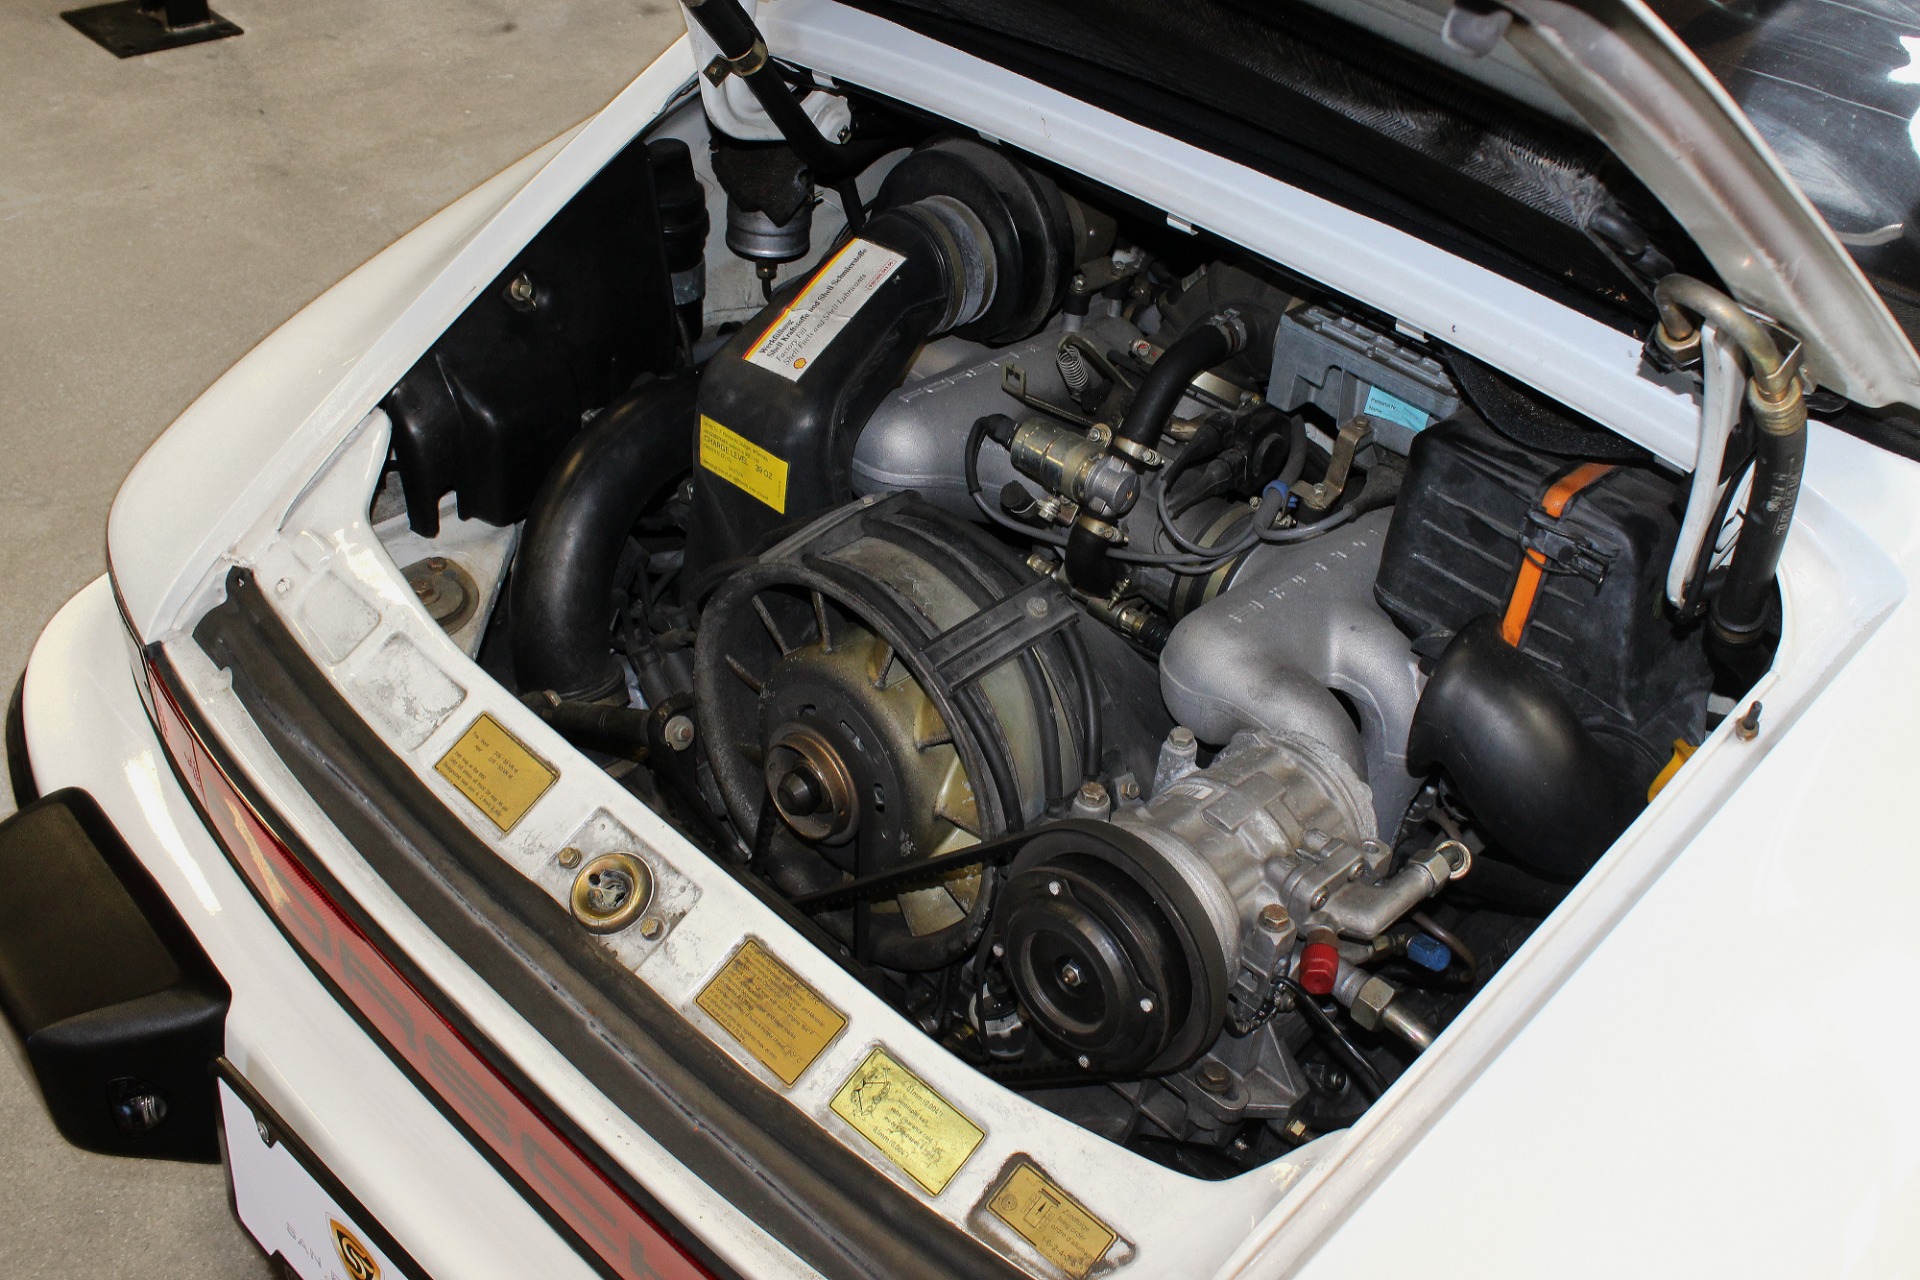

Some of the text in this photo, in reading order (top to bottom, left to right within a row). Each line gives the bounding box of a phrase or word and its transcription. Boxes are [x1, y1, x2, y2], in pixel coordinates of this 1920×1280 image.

[768, 342, 783, 357] Shell
[808, 301, 820, 312] und
[819, 286, 834, 300] Shell
[783, 274, 867, 365] Shell Fuels and Shell Lubricants
[776, 328, 807, 361] Factory Fill
[704, 434, 728, 453] CHARGE
[730, 450, 748, 465] LEVEL
[763, 470, 772, 479] OZ
[1051, 1225, 1065, 1236] ordre
[1071, 1228, 1085, 1240] order
